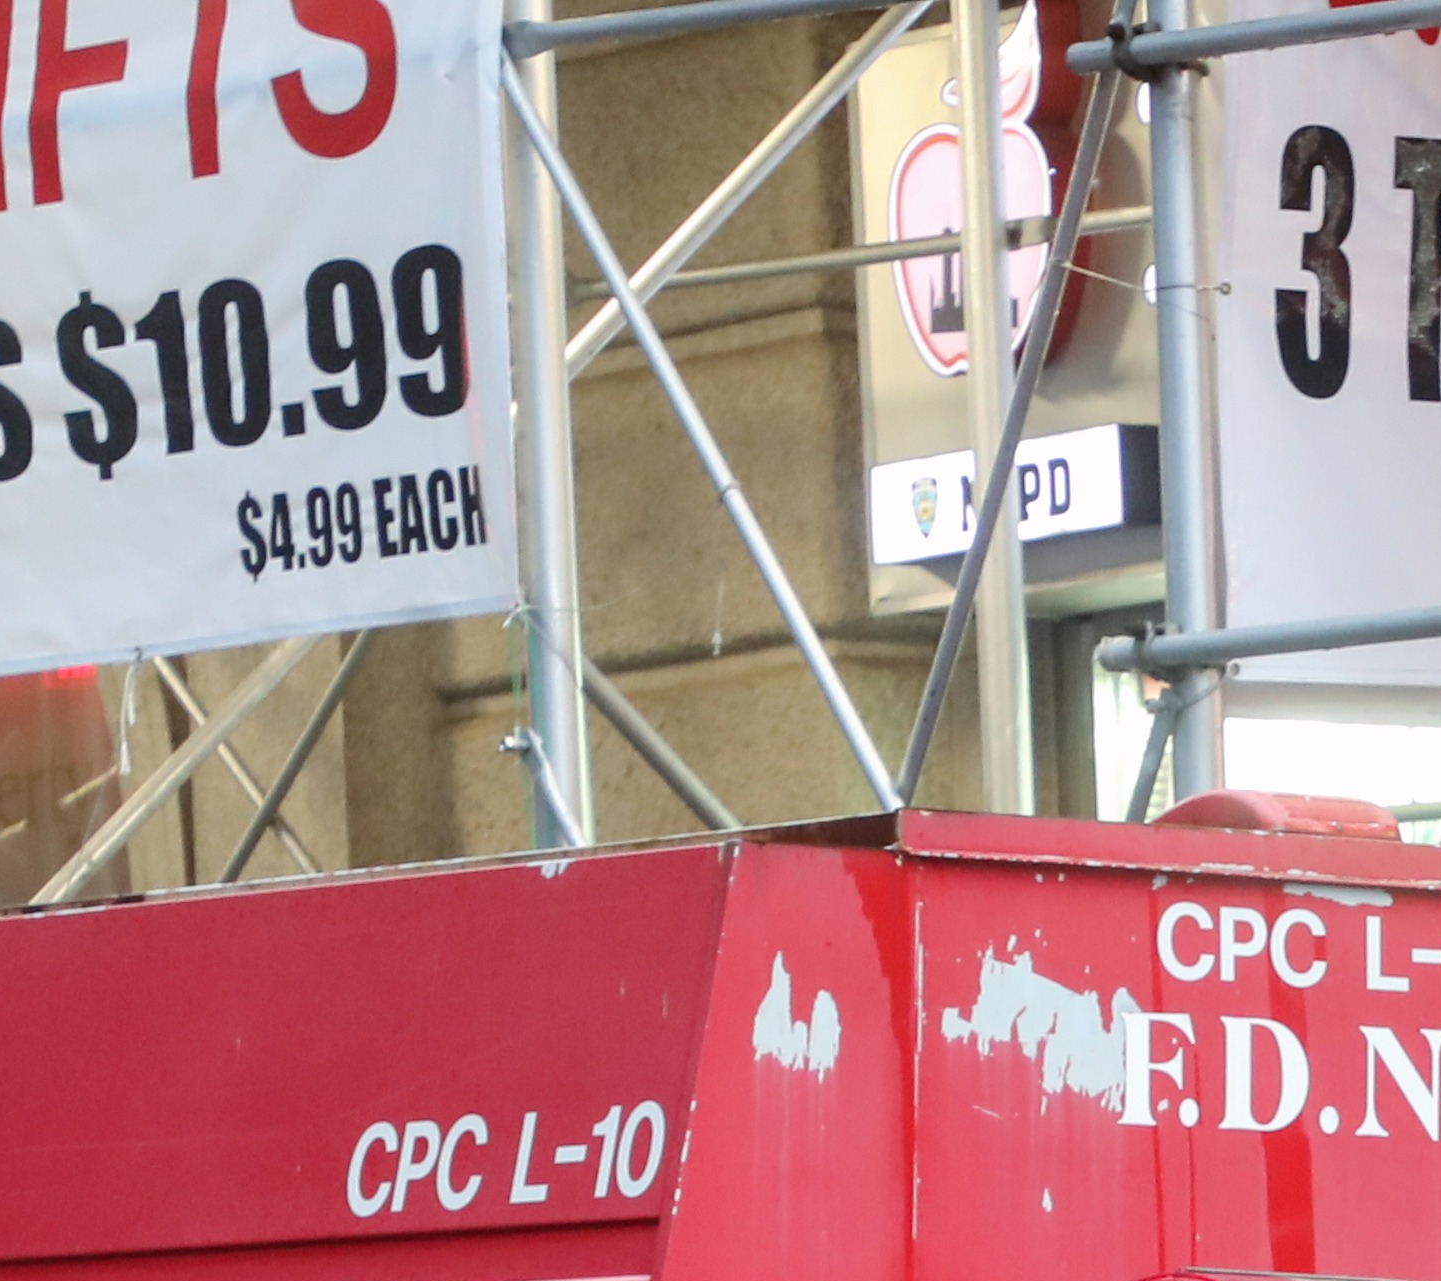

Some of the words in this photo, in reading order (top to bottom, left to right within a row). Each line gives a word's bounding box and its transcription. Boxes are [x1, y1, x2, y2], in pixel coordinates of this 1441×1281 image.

[1274, 124, 1355, 399] 3
[57, 242, 472, 481] $10.99
[238, 480, 362, 582] $4.99
[375, 463, 490, 561] EACH
[1158, 900, 1328, 989] CPC
[345, 1113, 489, 1220] CPC
[508, 1099, 667, 1206] L-10
